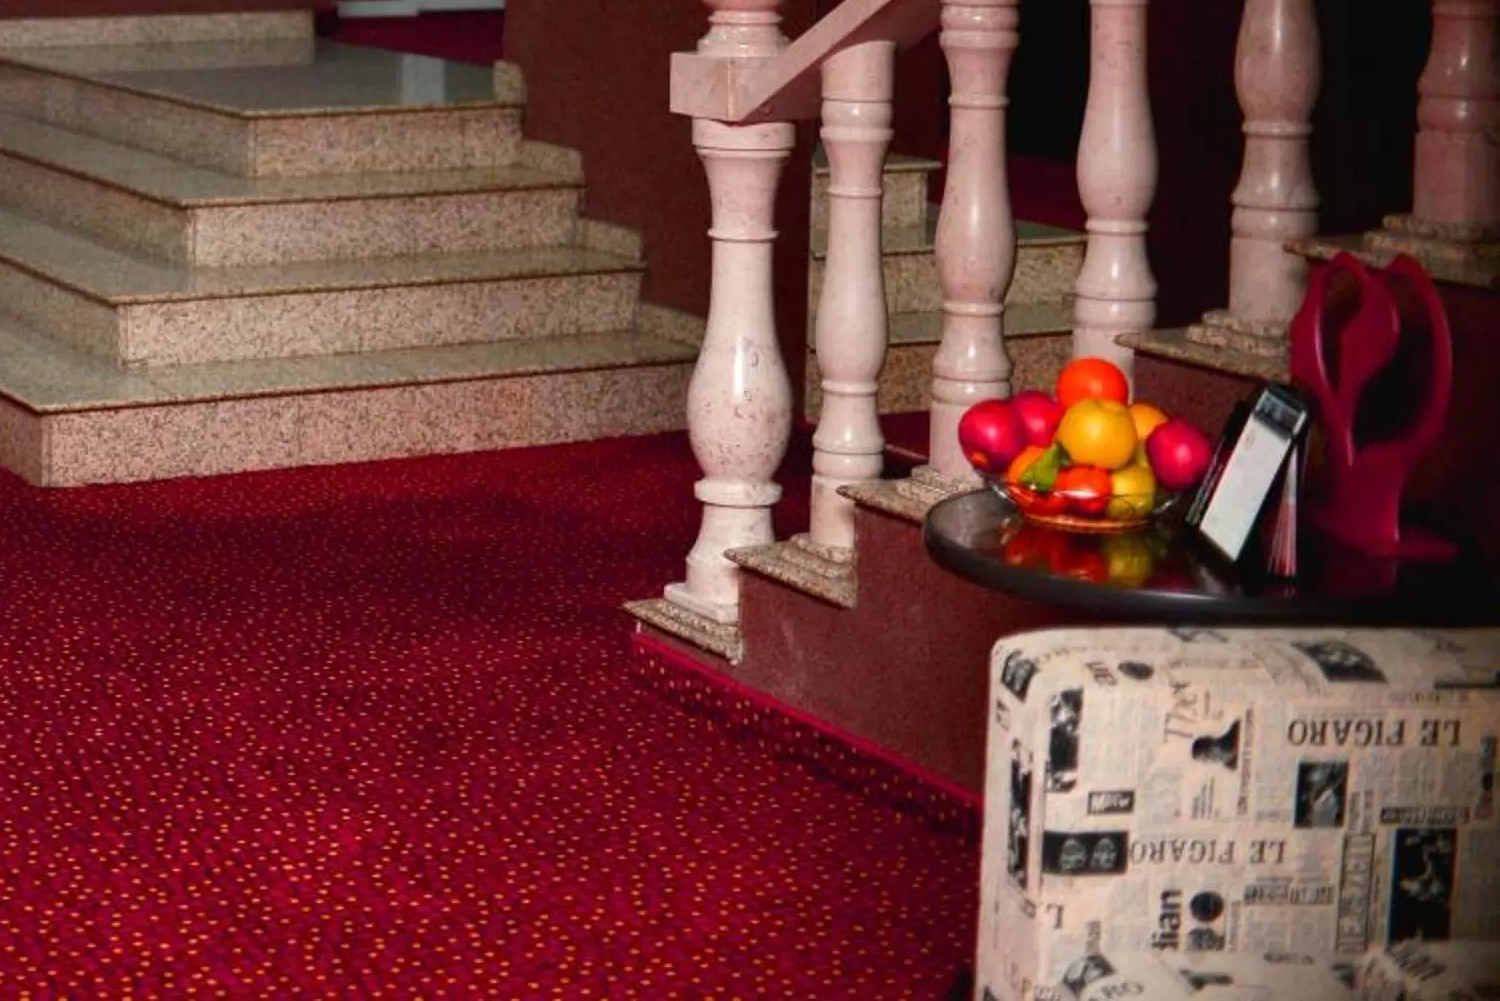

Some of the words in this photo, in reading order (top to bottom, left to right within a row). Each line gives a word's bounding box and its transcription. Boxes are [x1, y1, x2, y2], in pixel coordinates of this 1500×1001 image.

[1287, 718, 1405, 747] FIGARO
[1419, 718, 1461, 747] LE
[1130, 839, 1236, 865] FIGARO
[1249, 839, 1285, 864] LE
